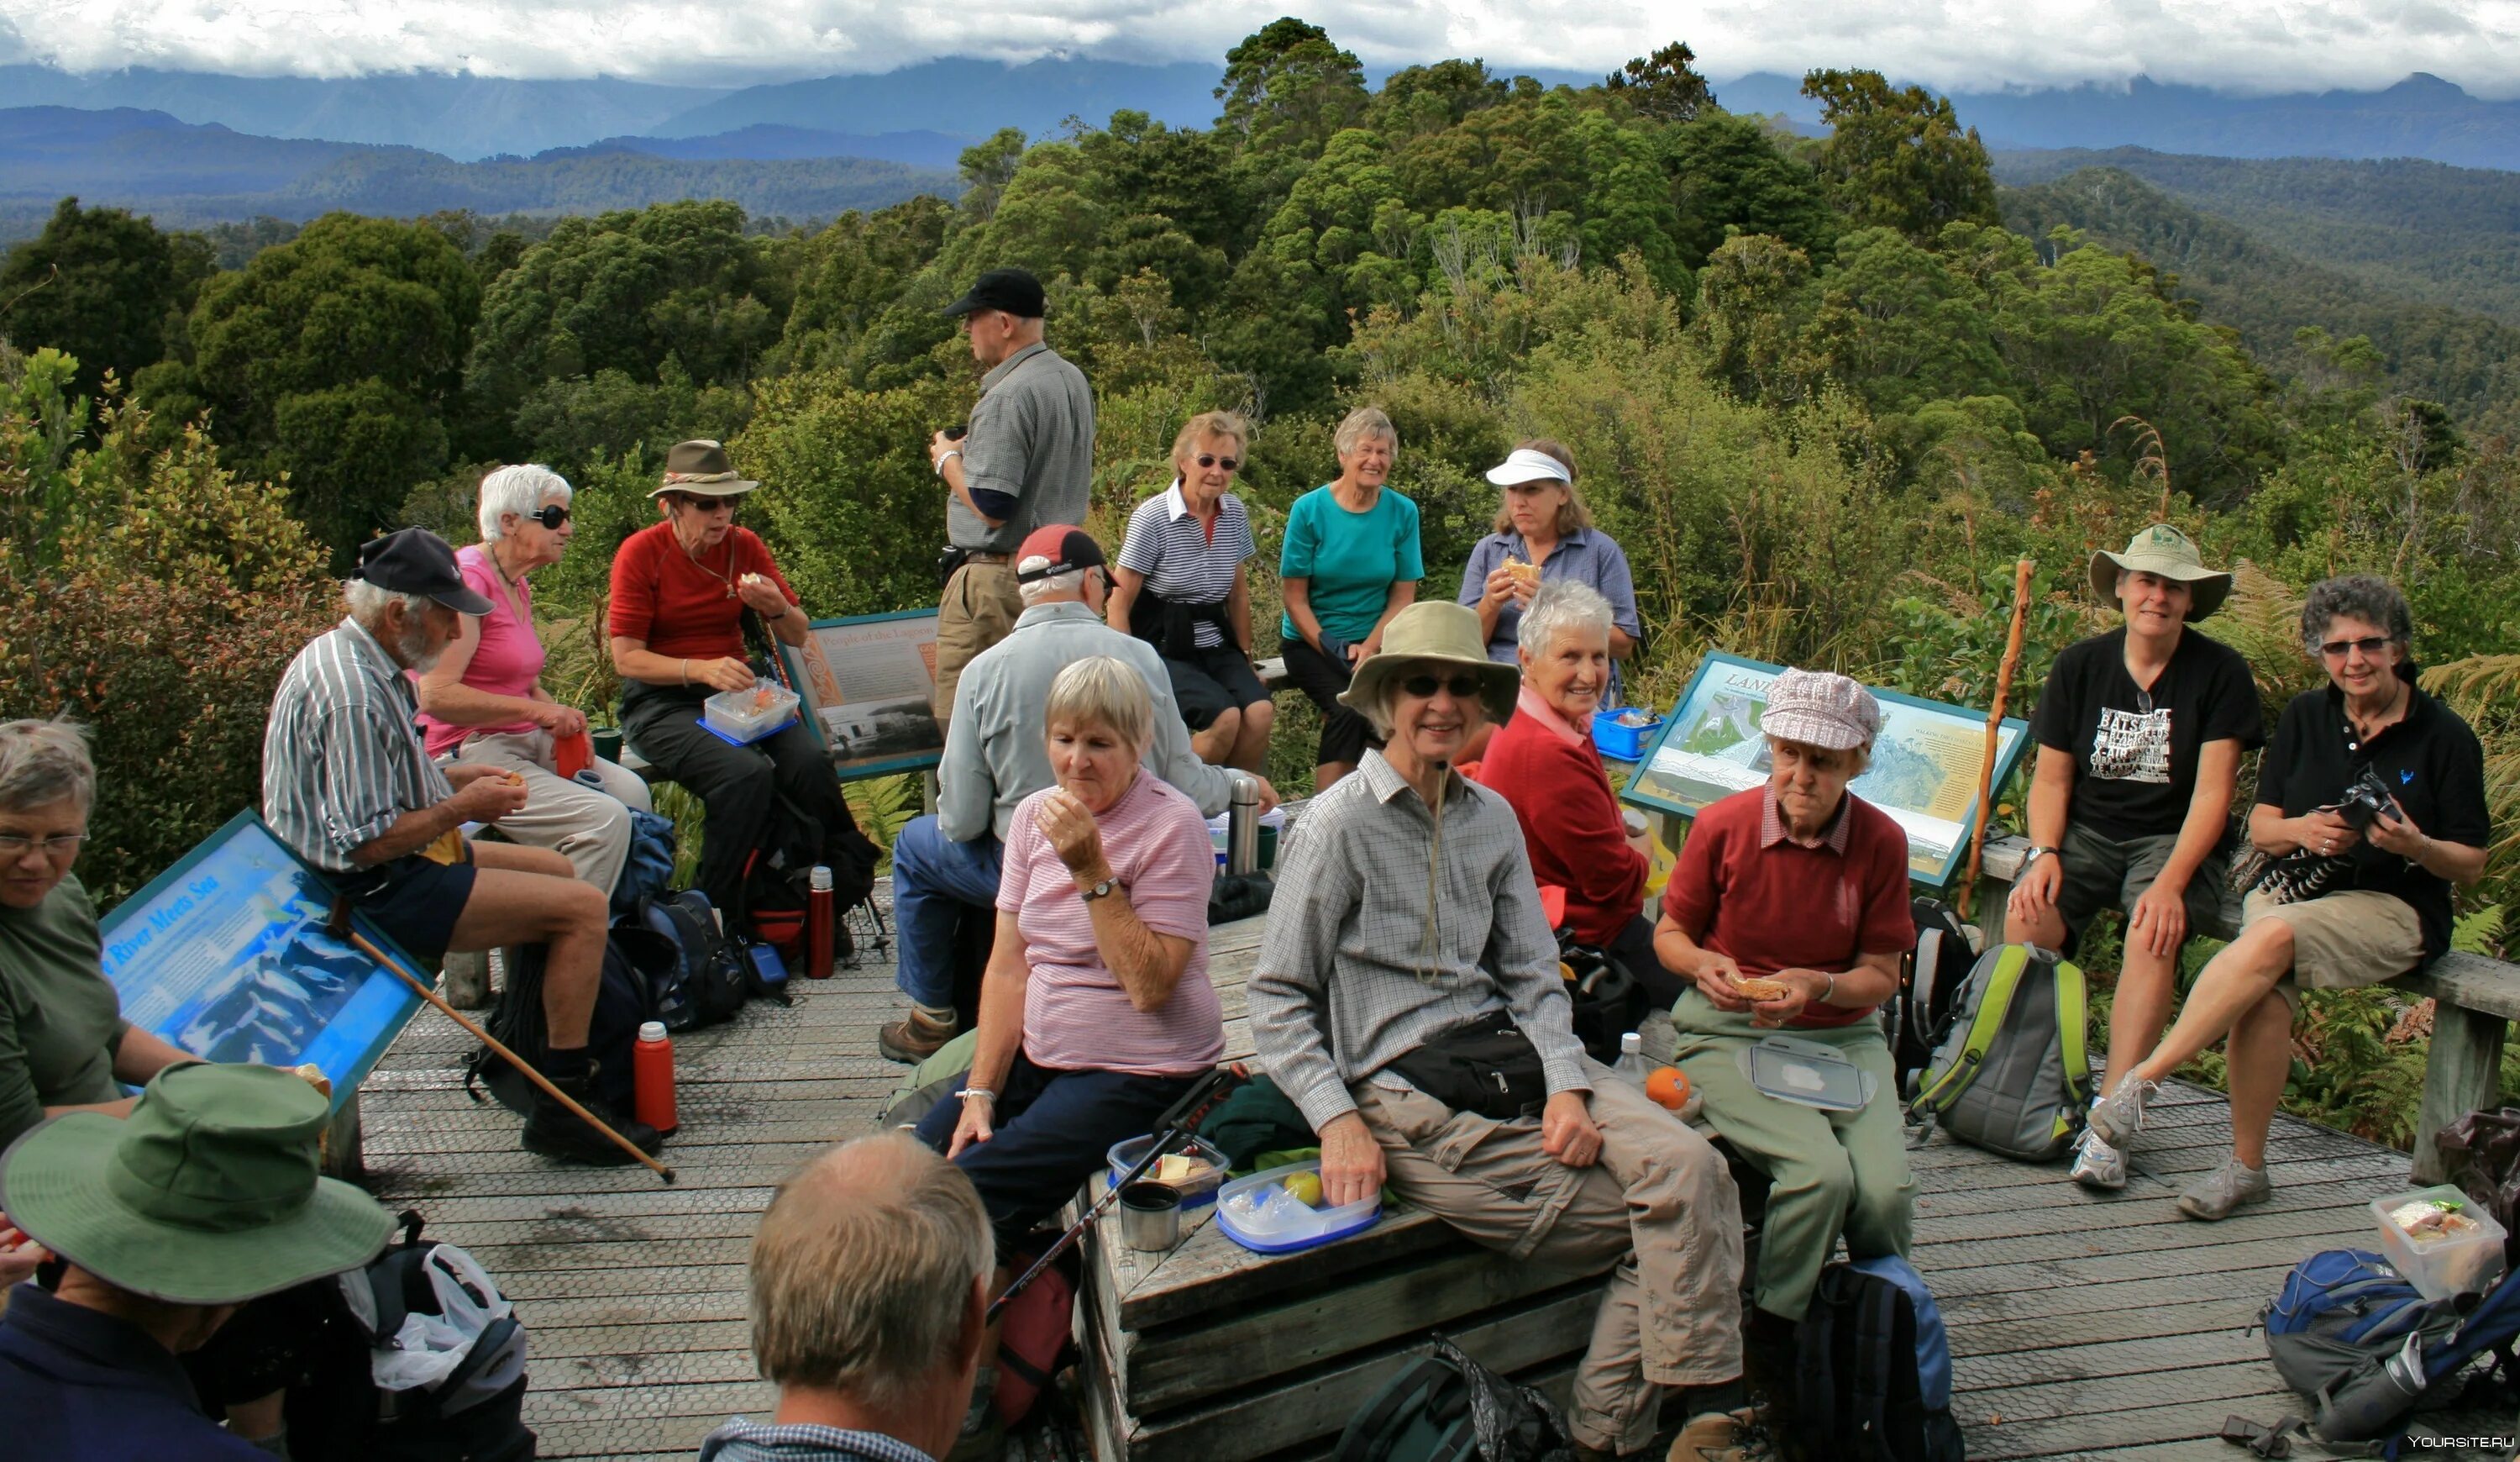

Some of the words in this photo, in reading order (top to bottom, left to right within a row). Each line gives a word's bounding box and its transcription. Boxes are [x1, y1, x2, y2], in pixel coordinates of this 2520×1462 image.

[822, 634, 861, 646] People
[862, 631, 874, 641] of
[874, 630, 892, 640] the
[894, 627, 933, 639] Lagoon
[2101, 714, 2138, 731] BATS
[109, 928, 152, 965] River
[148, 895, 194, 933] Meets
[188, 876, 219, 900] Sea
